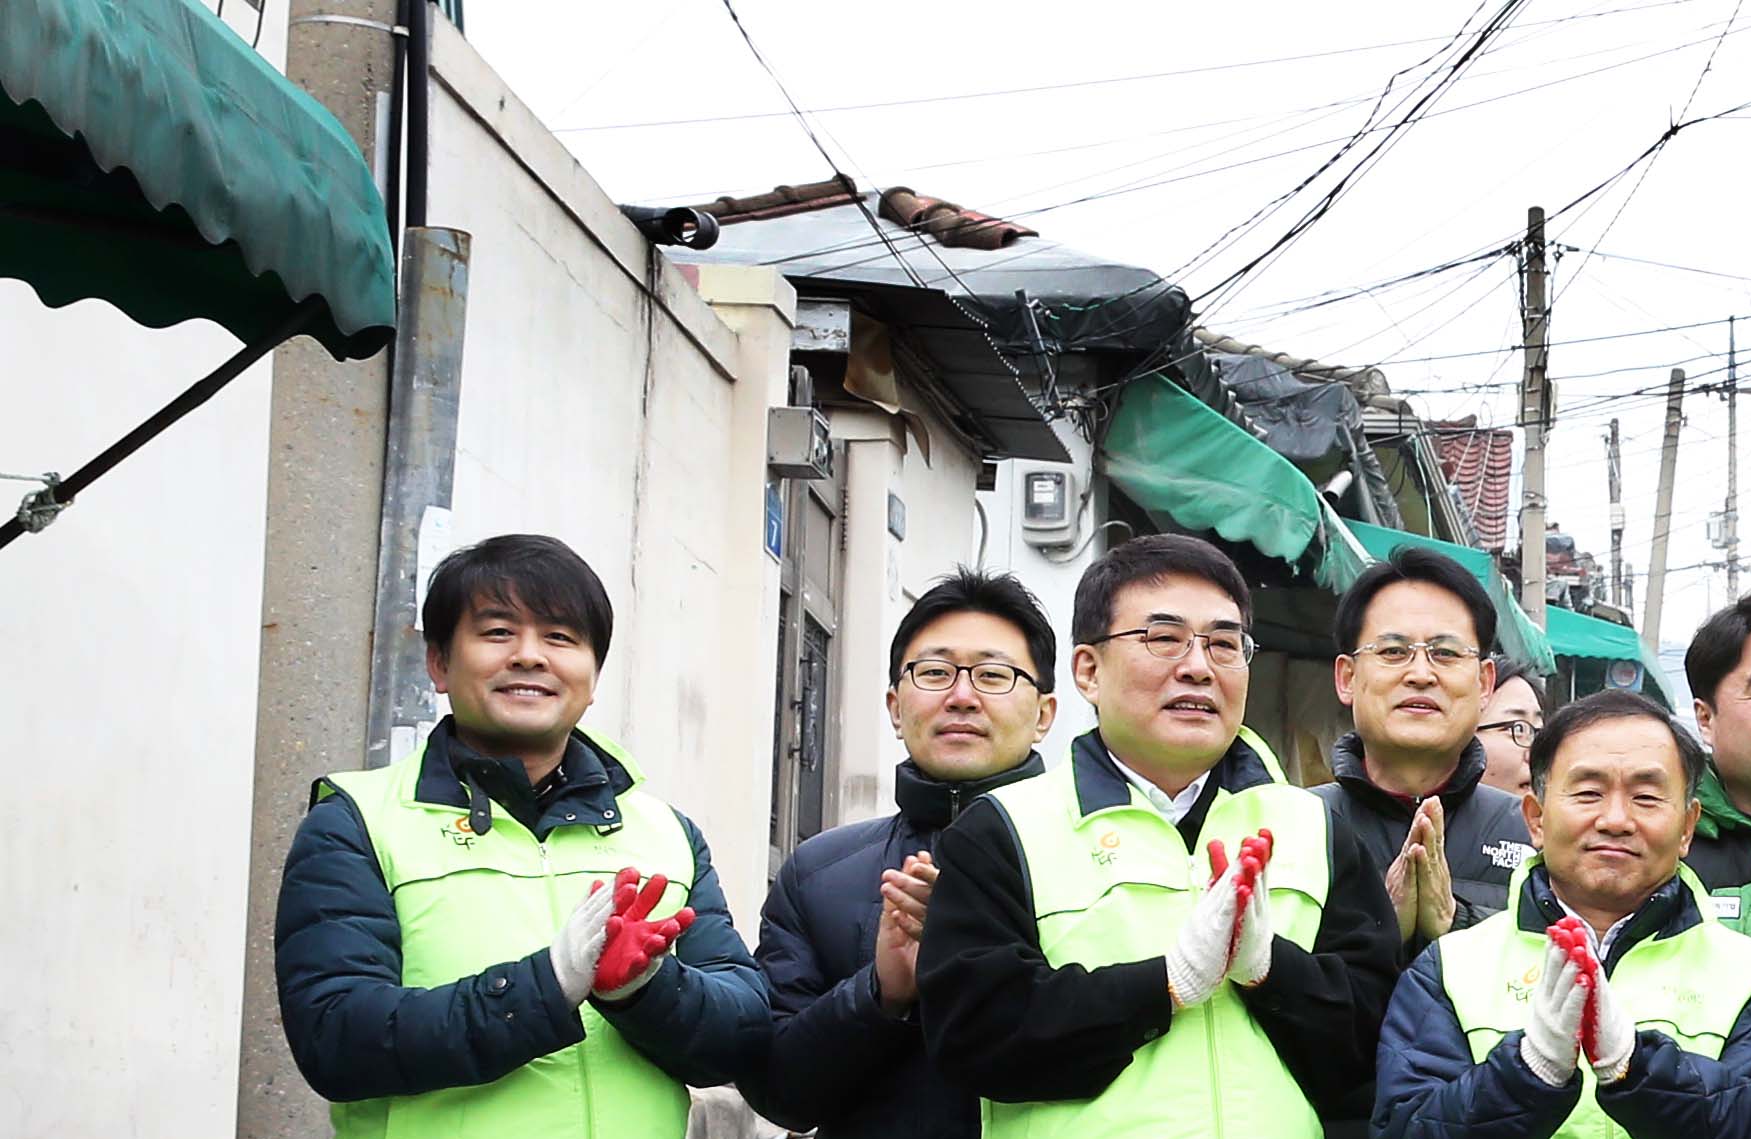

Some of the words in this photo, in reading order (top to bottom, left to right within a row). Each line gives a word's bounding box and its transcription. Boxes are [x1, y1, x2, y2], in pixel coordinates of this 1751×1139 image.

[1482, 844, 1521, 860] NORTH
[1499, 840, 1521, 852] THE
[1492, 856, 1521, 869] FACE
